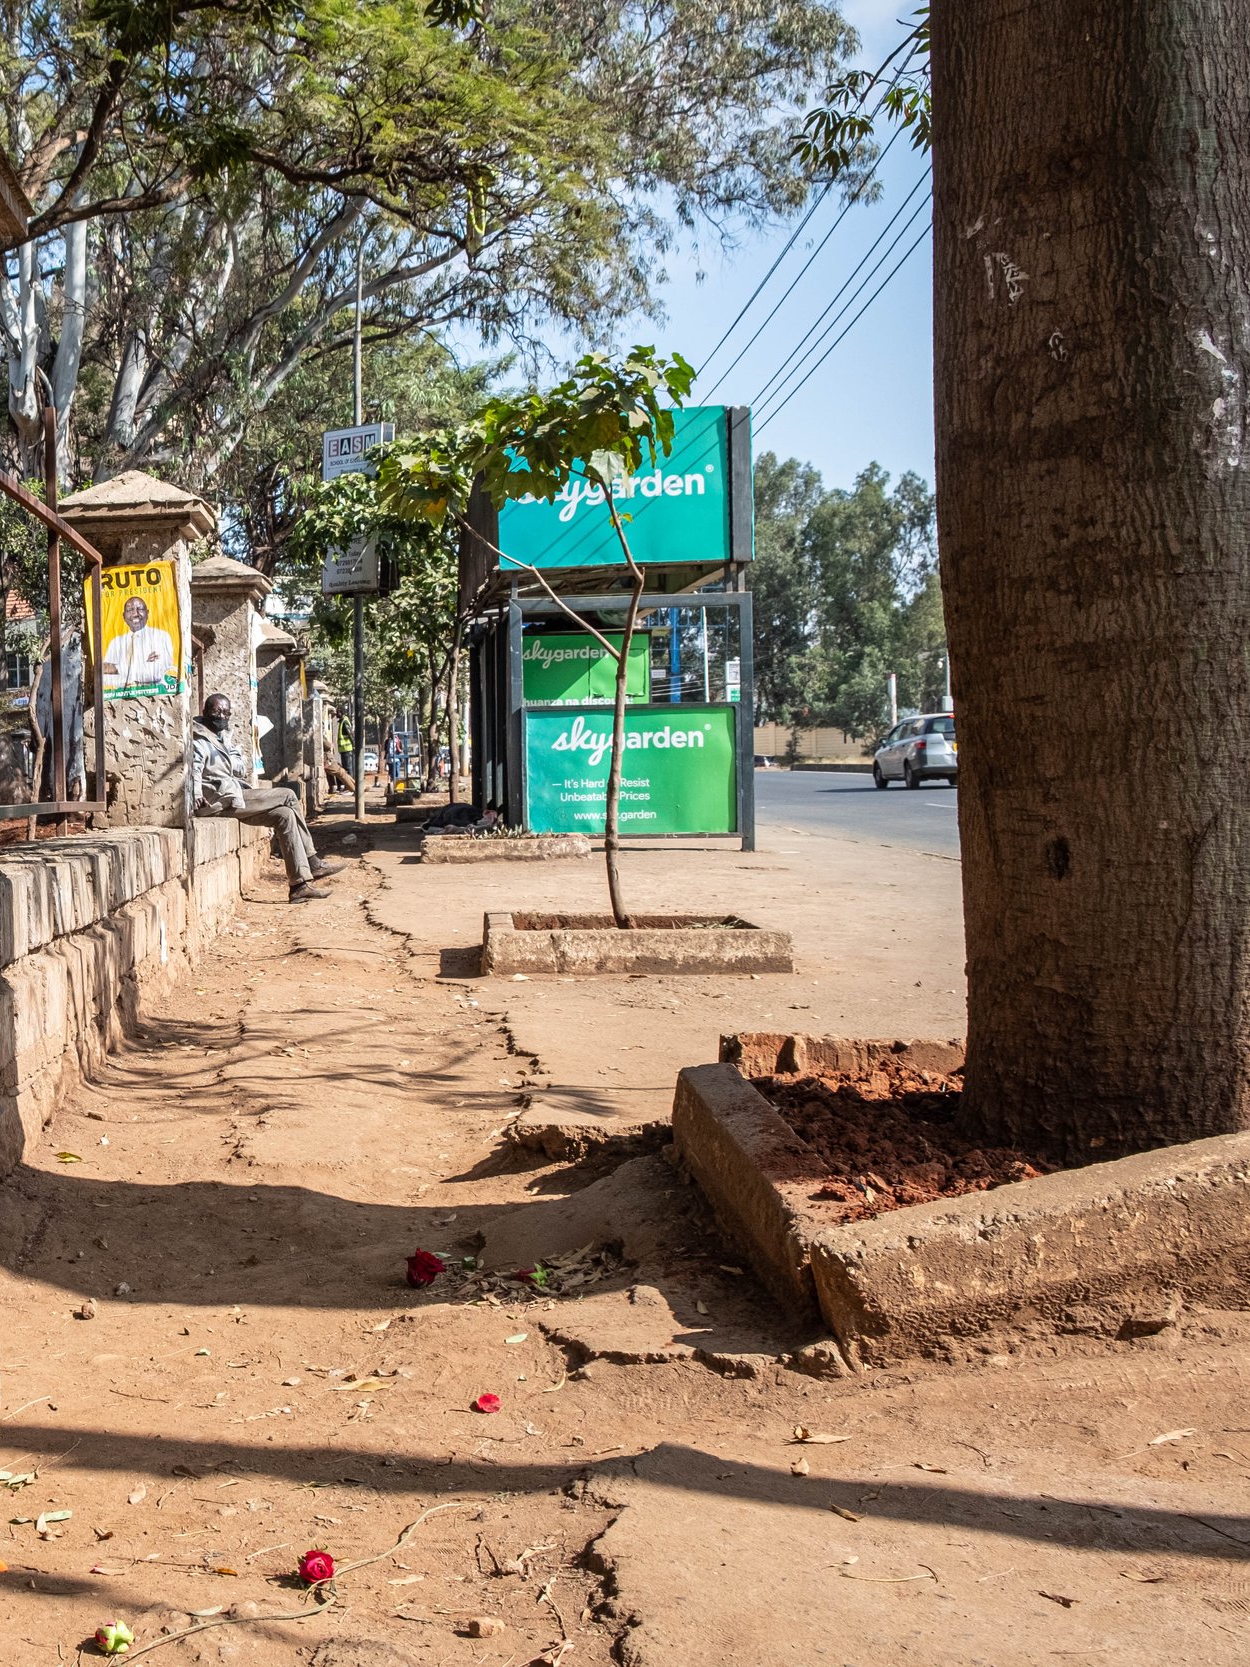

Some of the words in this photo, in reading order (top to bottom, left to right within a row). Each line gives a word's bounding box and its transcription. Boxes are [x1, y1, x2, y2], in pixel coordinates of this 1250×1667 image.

[101, 568, 161, 590] RUTO
[119, 586, 162, 596] PRESIDENT
[522, 640, 610, 669] skygarden
[581, 779, 605, 788] Hard
[620, 778, 650, 787] Resist
[619, 791, 650, 800] Prices
